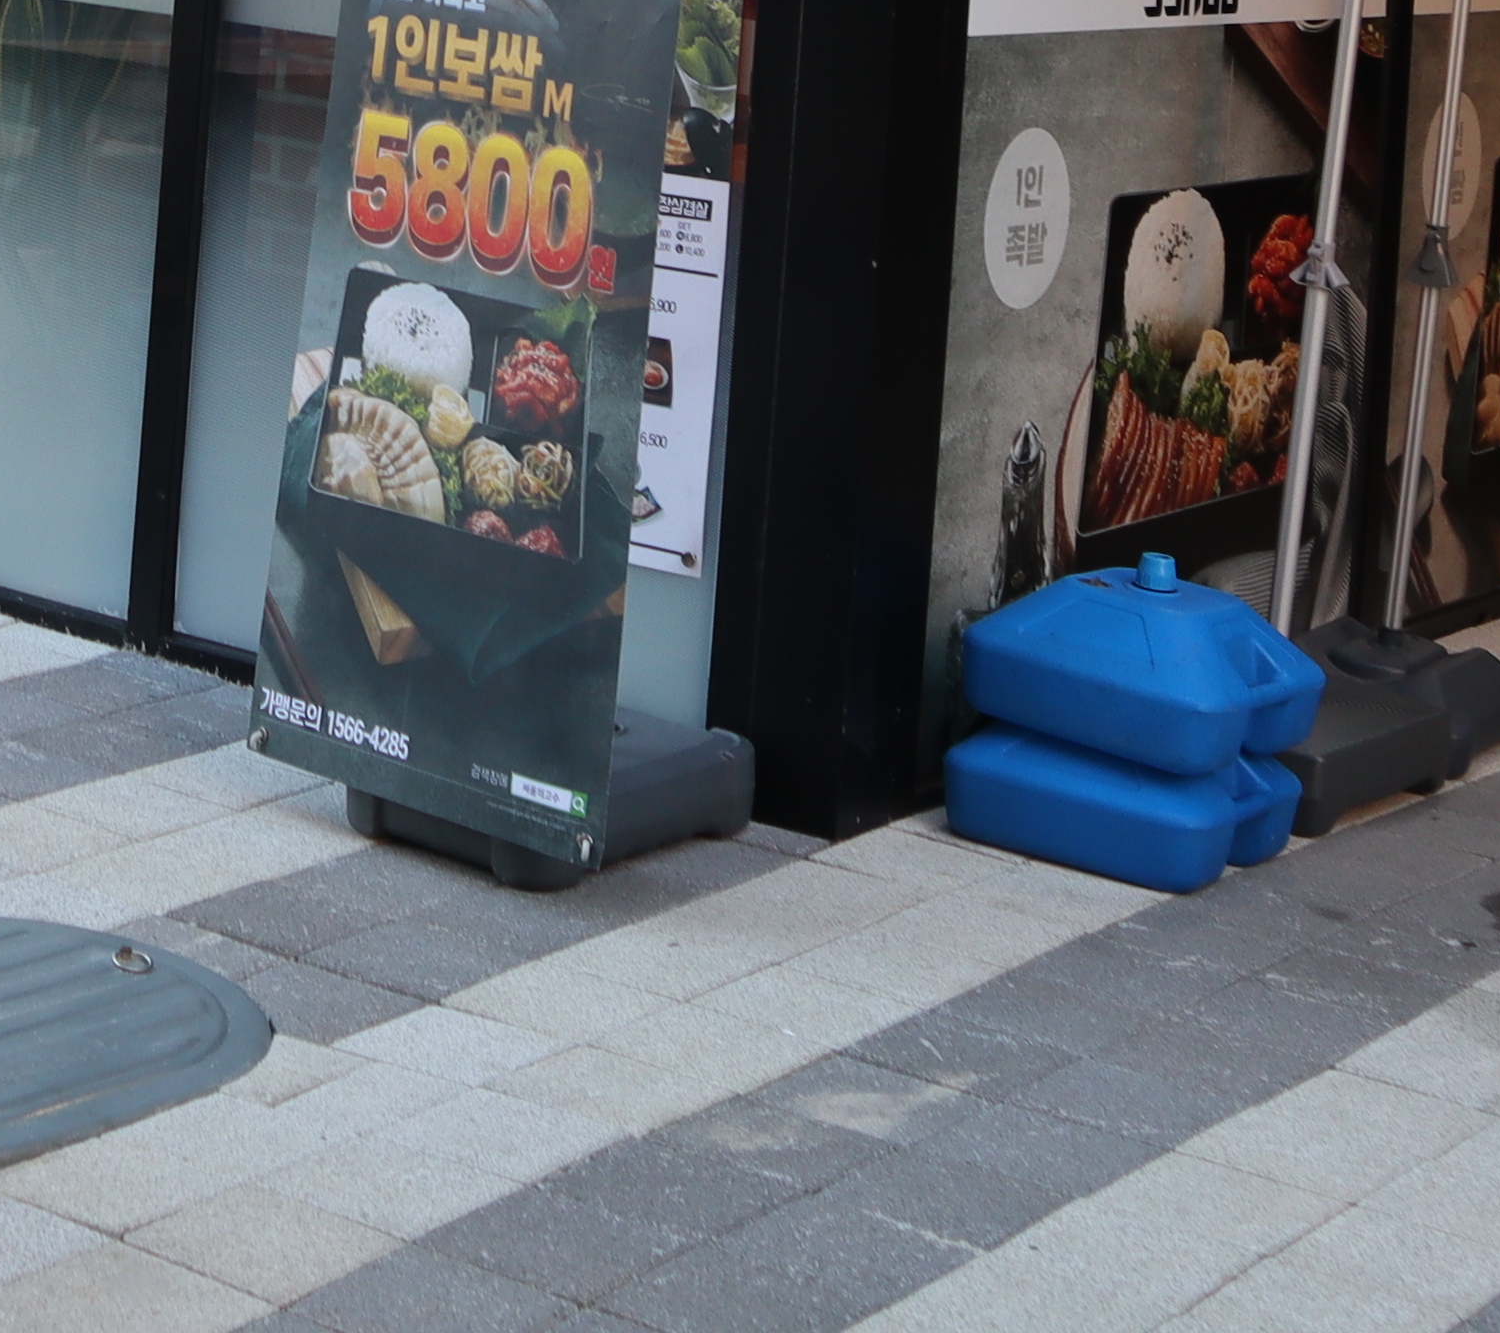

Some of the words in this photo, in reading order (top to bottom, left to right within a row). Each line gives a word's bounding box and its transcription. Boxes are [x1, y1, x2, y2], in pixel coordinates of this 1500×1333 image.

[367, 14, 544, 118] 1인보쌈
[543, 81, 574, 122] M
[1015, 164, 1044, 207] 1인
[1004, 220, 1048, 267] 족발
[259, 686, 322, 733] 가맹문의
[326, 708, 410, 761] 1566-4285
